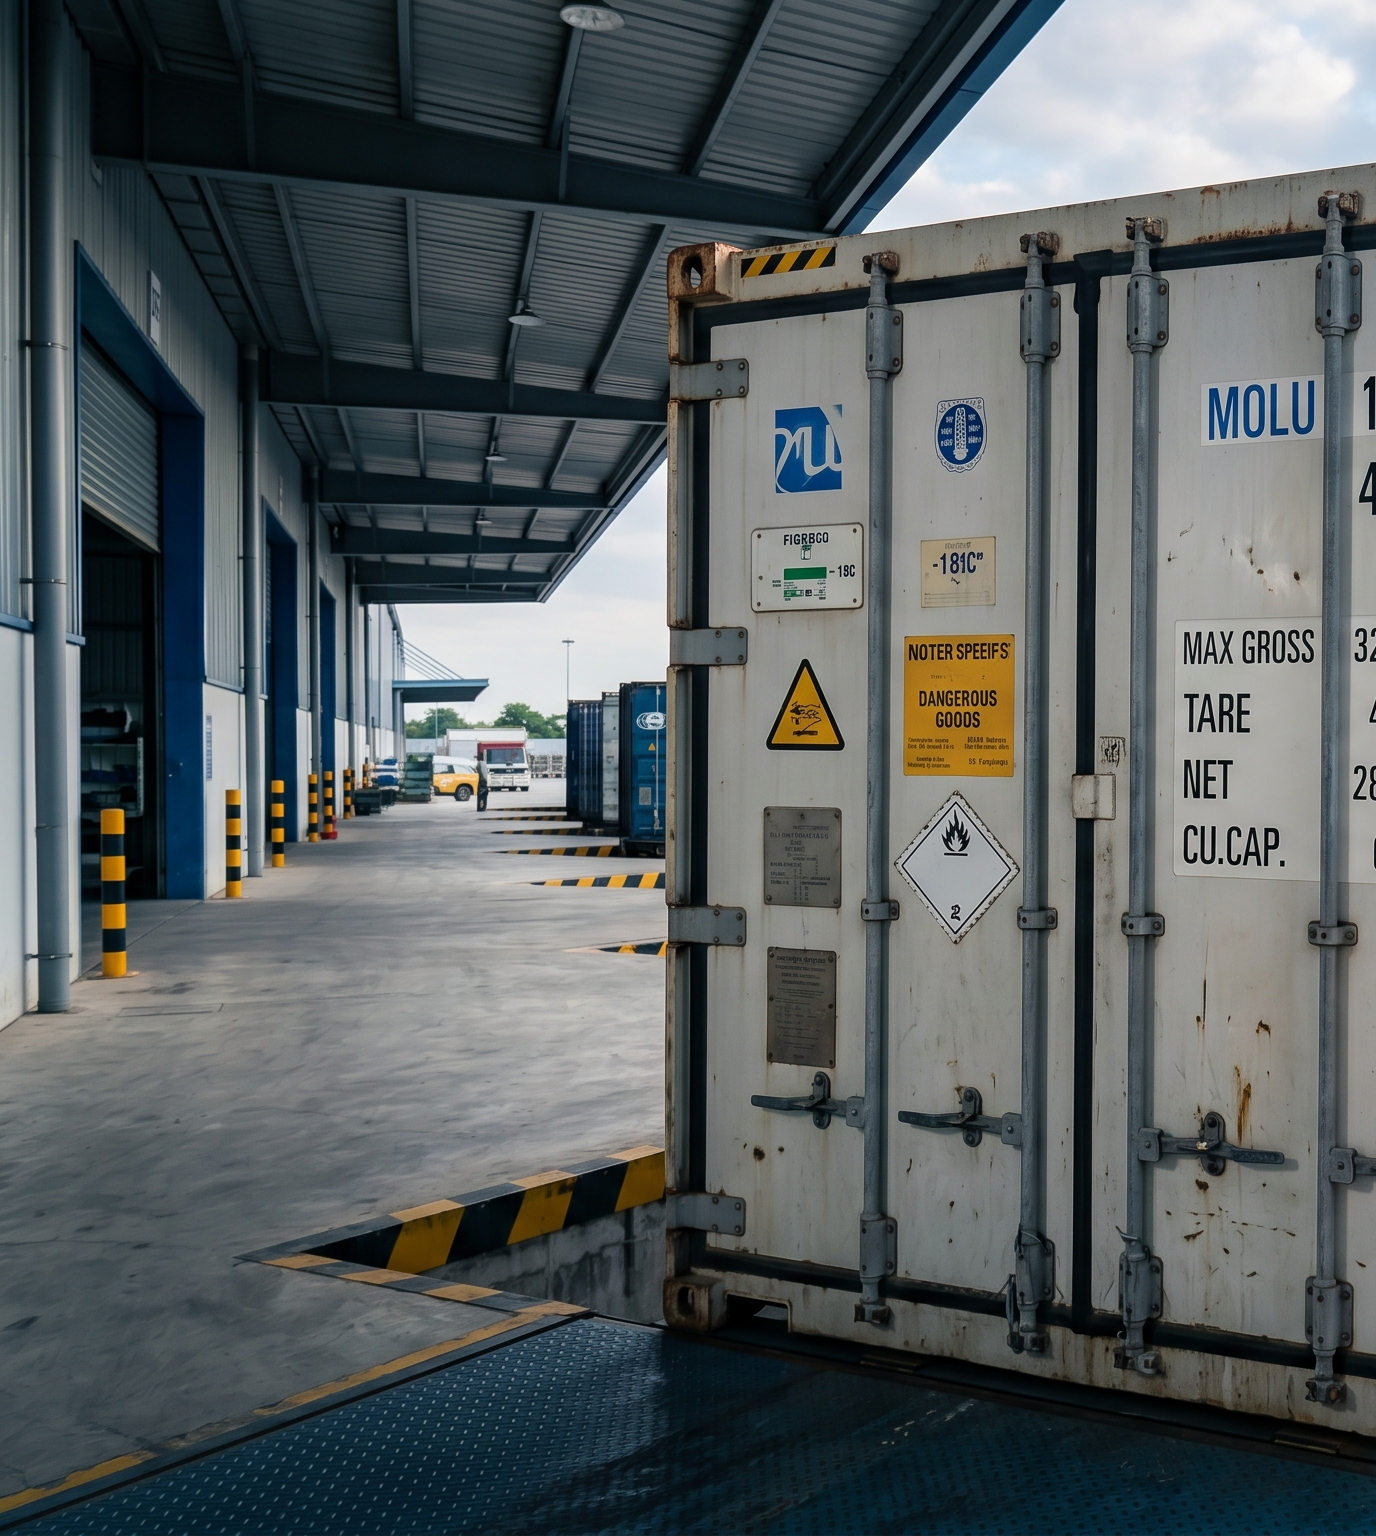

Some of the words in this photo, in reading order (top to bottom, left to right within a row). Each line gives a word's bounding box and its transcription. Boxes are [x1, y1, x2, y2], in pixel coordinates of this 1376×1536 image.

[1208, 380, 1315, 441] MOLU
[908, 643, 953, 661] NOTER
[1183, 631, 1234, 665] MAX
[1241, 629, 1315, 664] GROSS
[919, 689, 998, 707] DANGEROUS
[1183, 693, 1251, 733] TARE
[935, 711, 981, 729] GOODS
[1183, 759, 1234, 800] NET
[1183, 824, 1286, 867] CU.CAP.
[950, 903, 961, 922] 2
